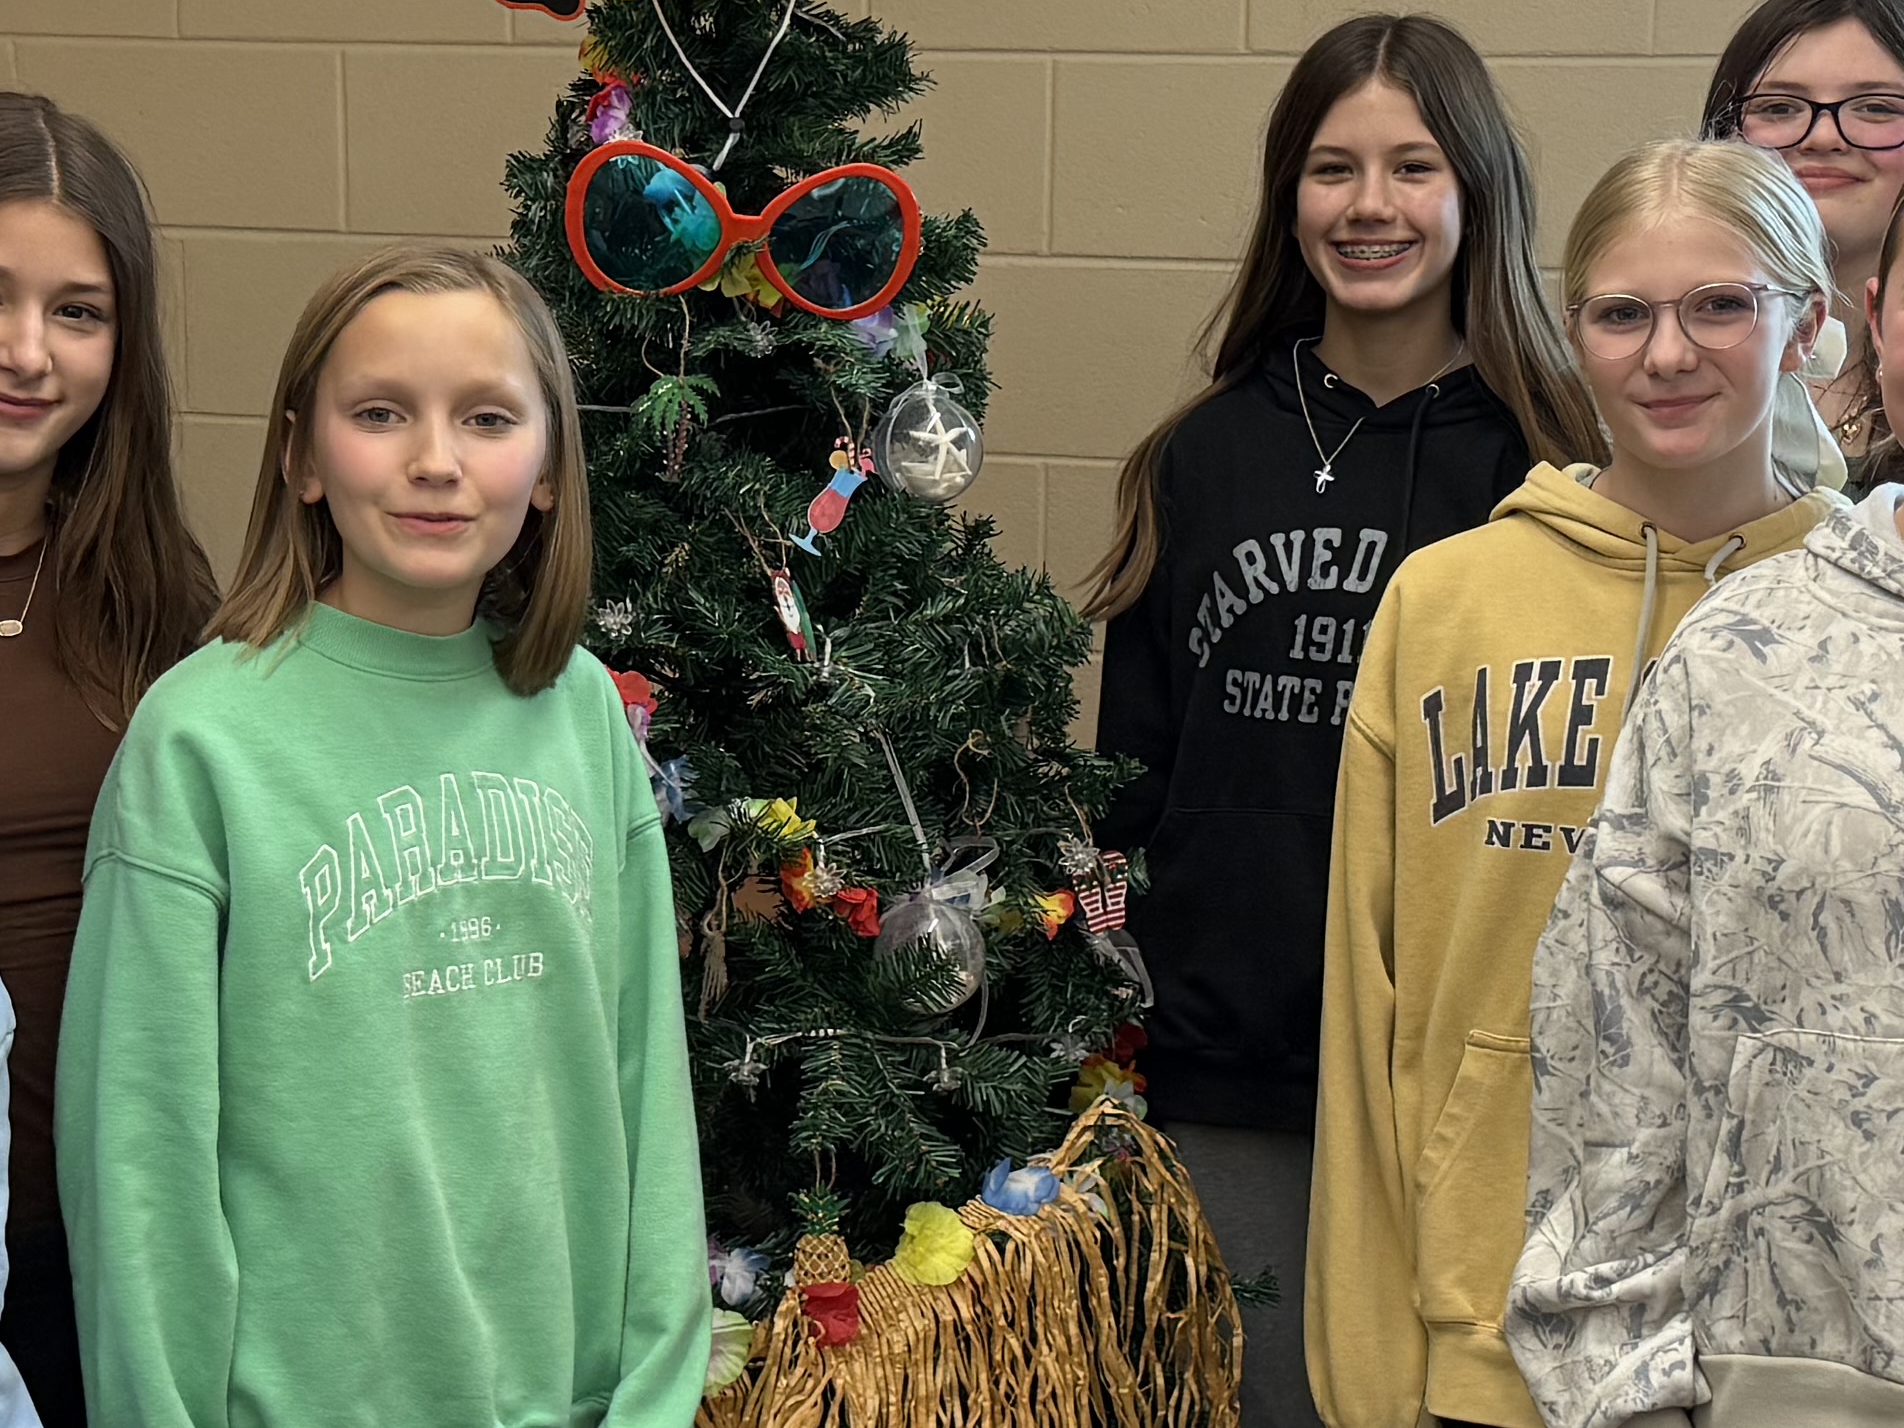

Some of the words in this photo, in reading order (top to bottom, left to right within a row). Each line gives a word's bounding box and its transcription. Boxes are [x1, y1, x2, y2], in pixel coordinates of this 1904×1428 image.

[1189, 527, 1389, 668] STARVED
[1223, 669, 1323, 724] STATE
[1421, 655, 1614, 826] LAKE
[1484, 818, 1586, 856] NEV
[483, 952, 544, 986] CLUB
